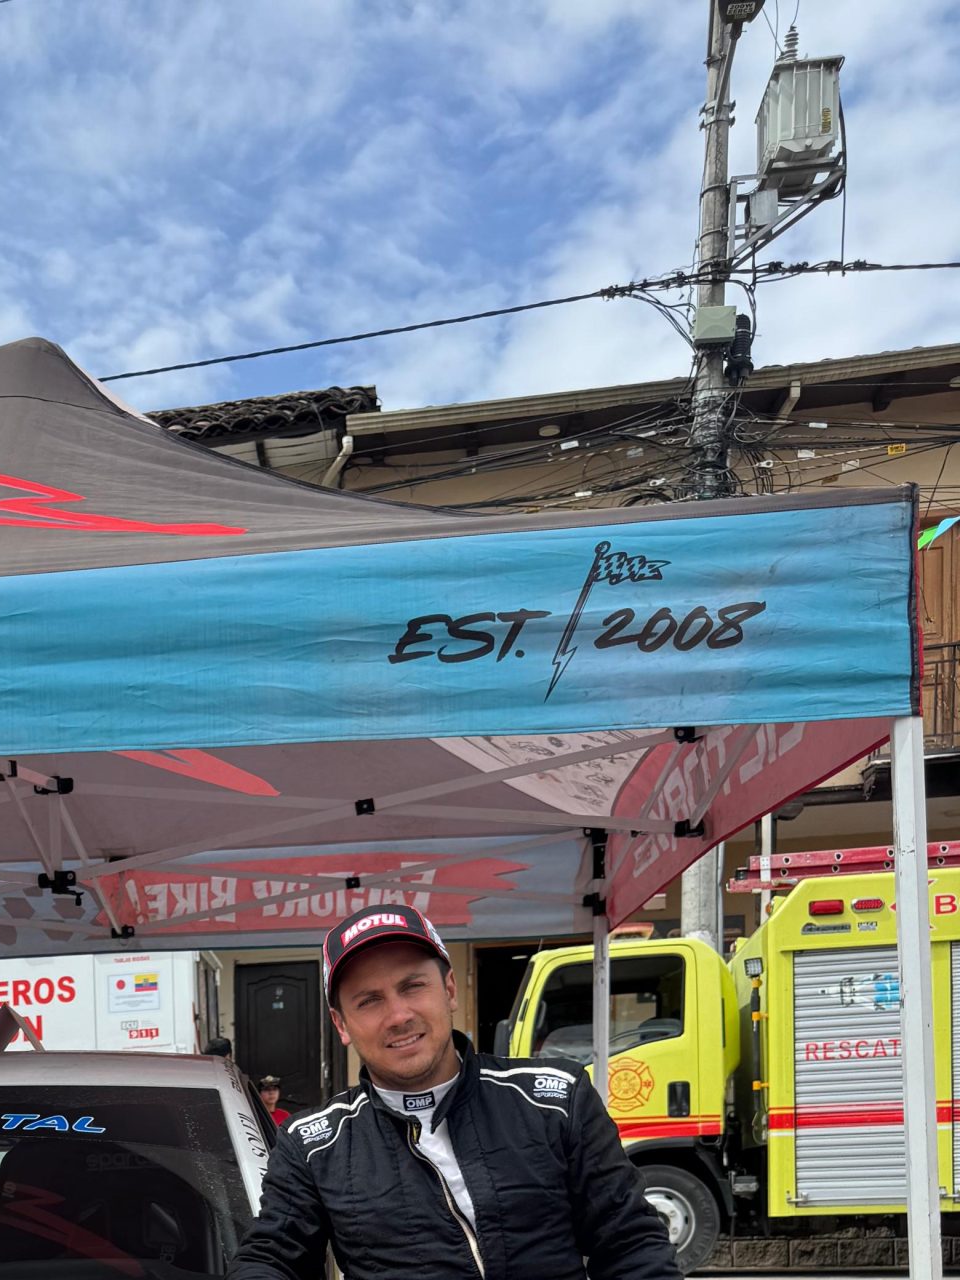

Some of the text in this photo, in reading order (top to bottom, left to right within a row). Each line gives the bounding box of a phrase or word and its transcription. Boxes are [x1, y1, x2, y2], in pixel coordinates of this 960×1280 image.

[387, 600, 766, 665] EST. 2008
[934, 894, 960, 915] B
[343, 912, 406, 943] MOTUL
[129, 1028, 159, 1039] 911
[804, 1038, 902, 1062] RESCAT
[534, 1077, 568, 1091] OMP
[406, 1096, 433, 1109] OMP
[299, 1118, 330, 1136] OMP
